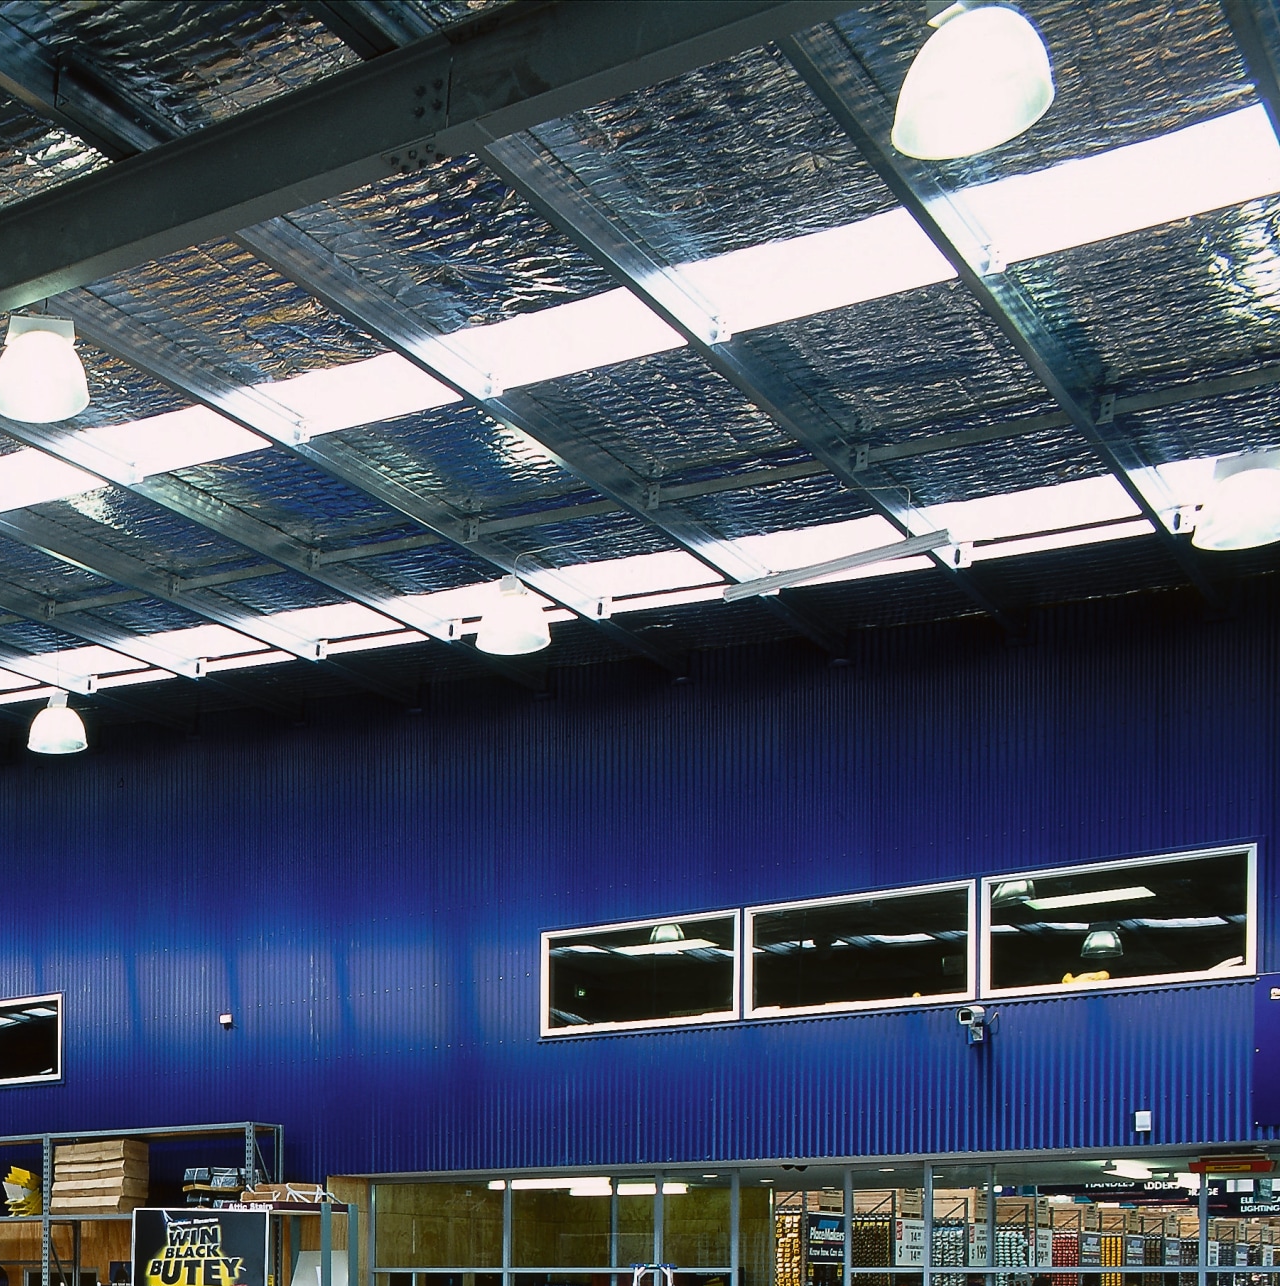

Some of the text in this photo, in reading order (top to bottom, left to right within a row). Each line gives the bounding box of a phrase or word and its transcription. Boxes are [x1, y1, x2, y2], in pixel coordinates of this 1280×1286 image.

[168, 1226, 220, 1247] WIN
[810, 1226, 845, 1241] PlaceMakers
[165, 1245, 220, 1258] BLACK
[149, 1258, 240, 1286] BUTEY
